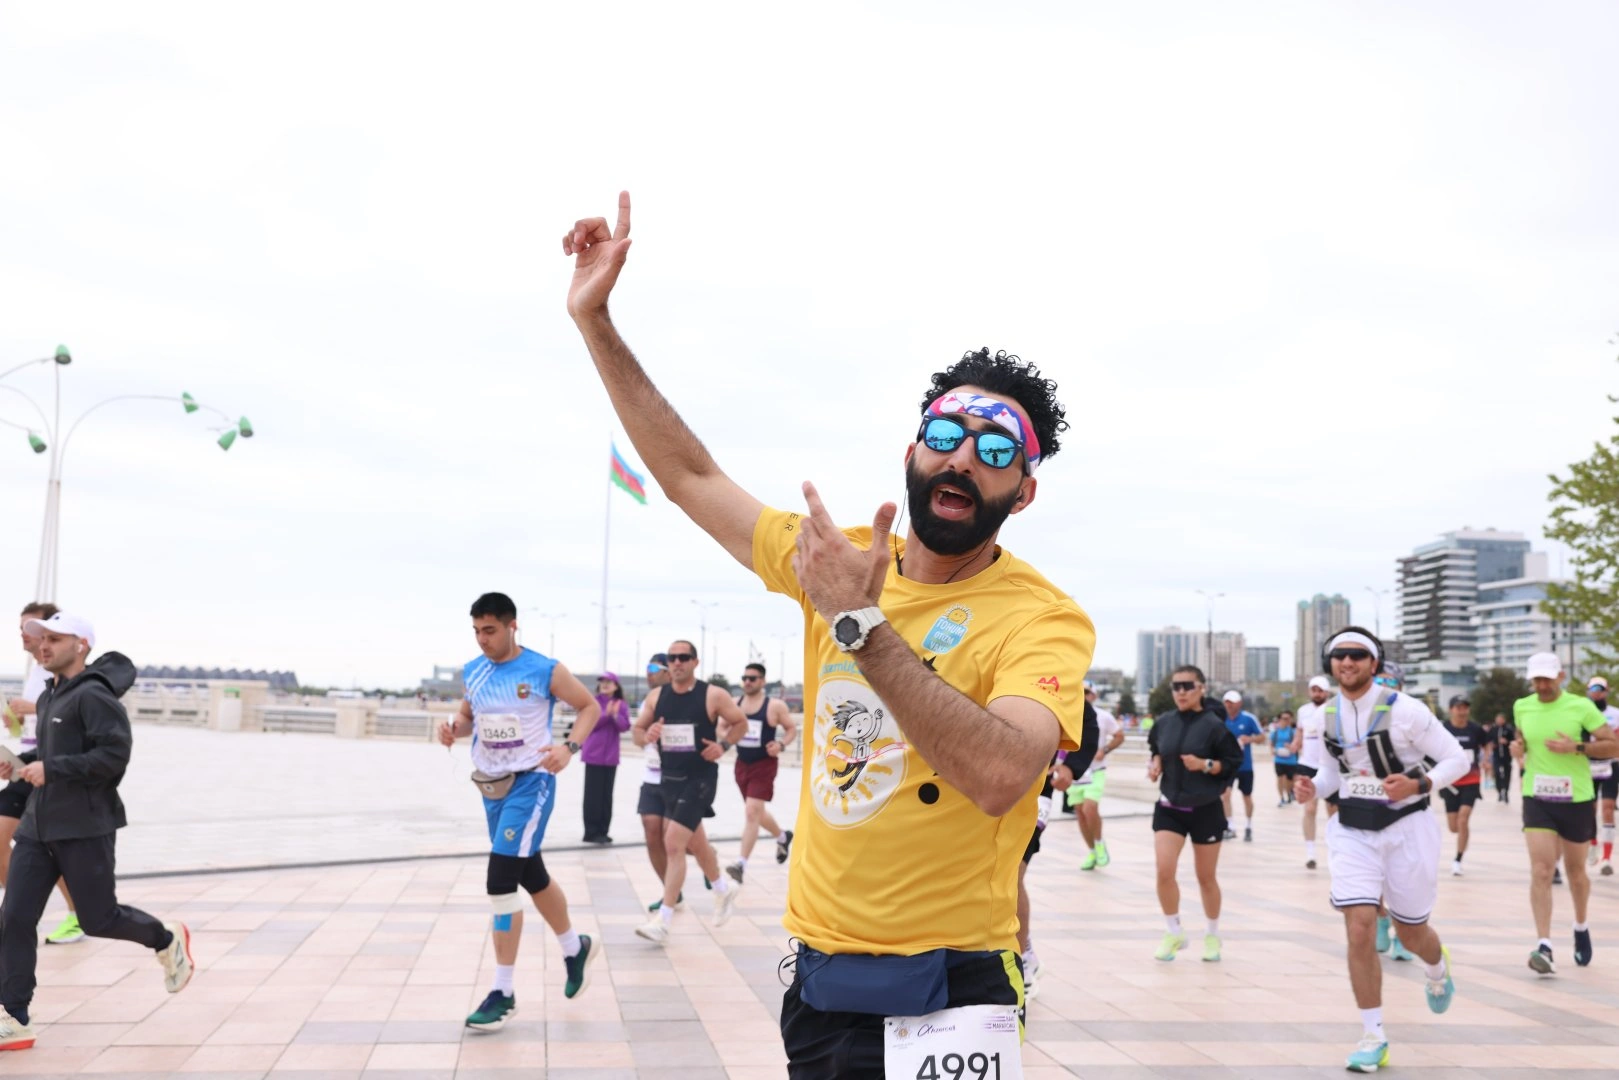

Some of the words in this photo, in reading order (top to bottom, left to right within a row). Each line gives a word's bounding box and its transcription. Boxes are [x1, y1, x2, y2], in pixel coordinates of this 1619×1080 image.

[936, 618, 966, 637] TOHUM
[483, 727, 517, 739] 13463
[859, 746, 864, 757] 1
[1351, 783, 1384, 796] 2336
[916, 1052, 1000, 1080] 4991
